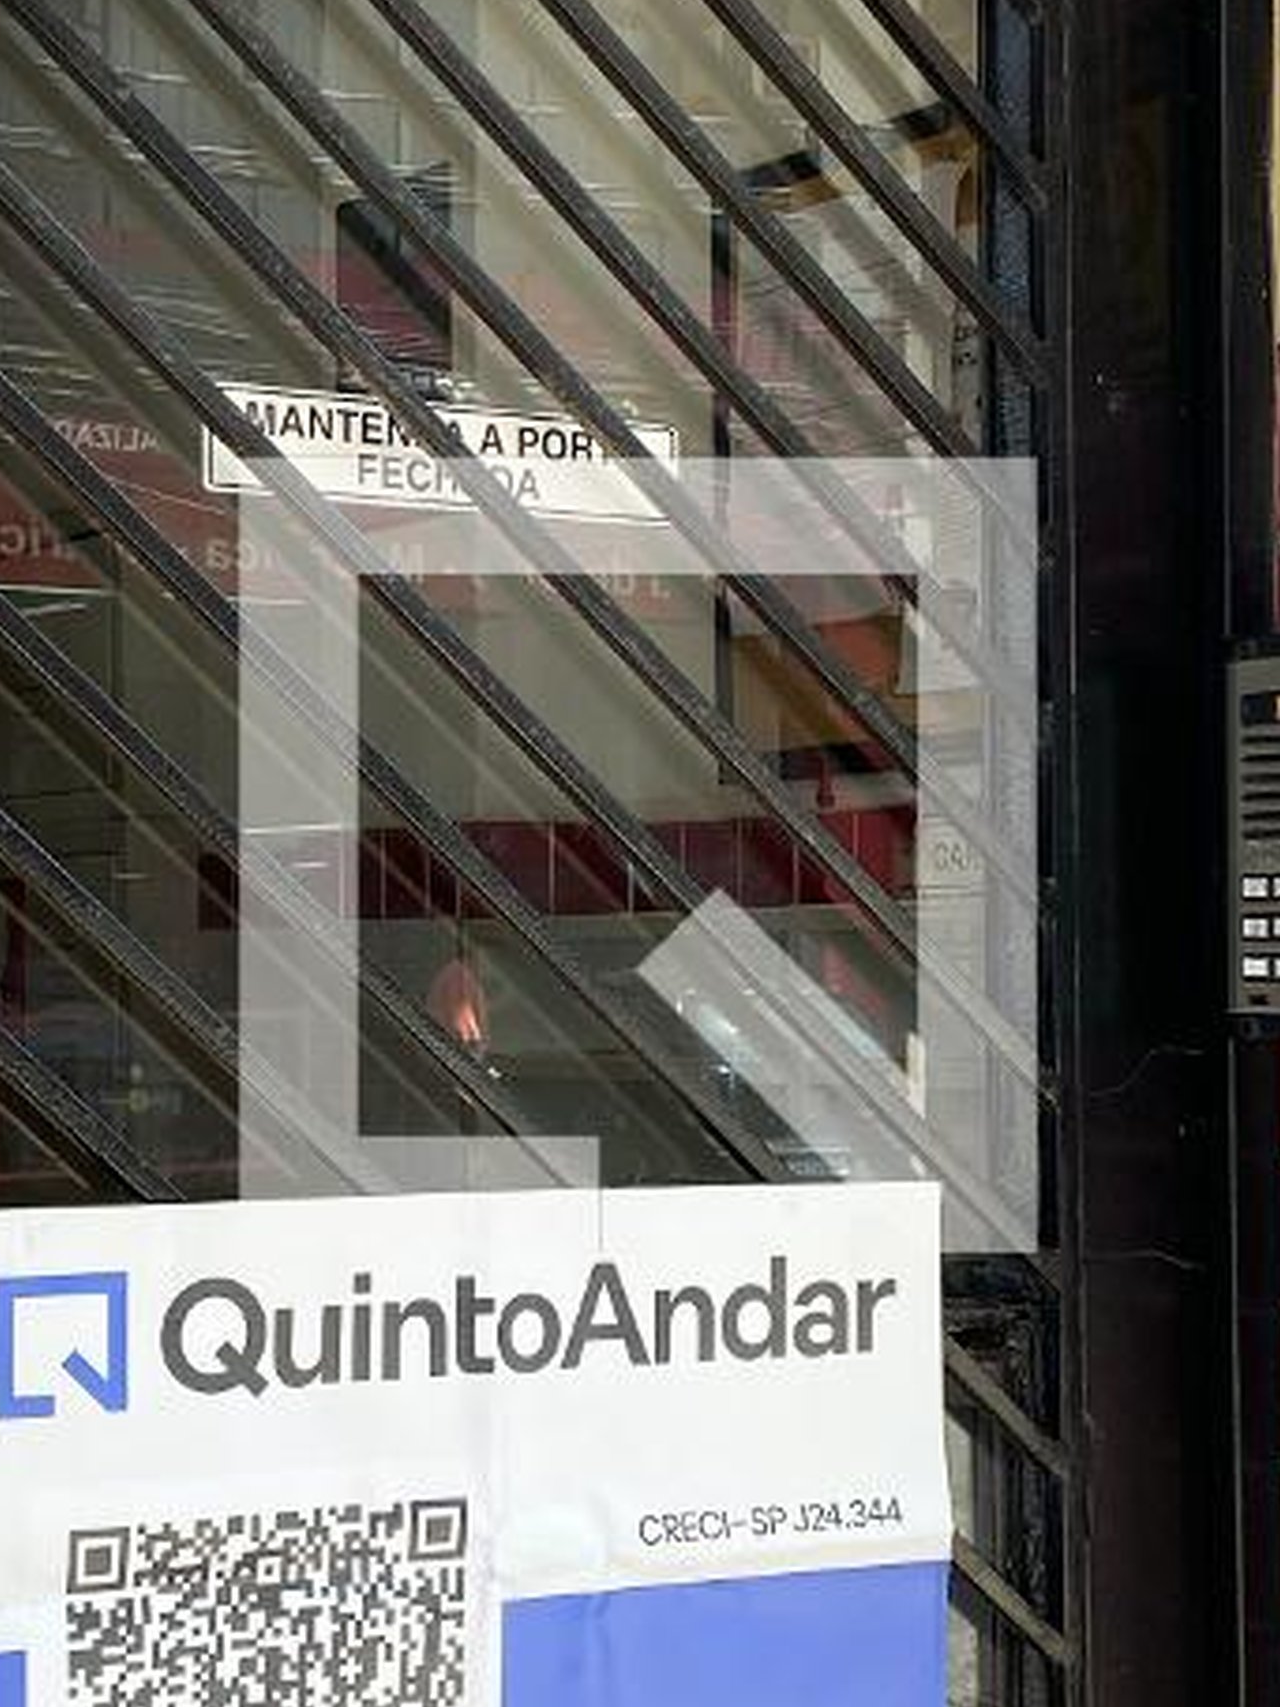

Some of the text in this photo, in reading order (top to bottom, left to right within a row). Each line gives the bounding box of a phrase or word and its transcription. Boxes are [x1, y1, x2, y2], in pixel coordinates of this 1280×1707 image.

[246, 400, 610, 464] MANTENA A POR
[357, 452, 540, 500] FECHDA
[159, 1255, 899, 1399] QuintoAndar
[638, 1497, 904, 1546] CRECI-SP J24.344
